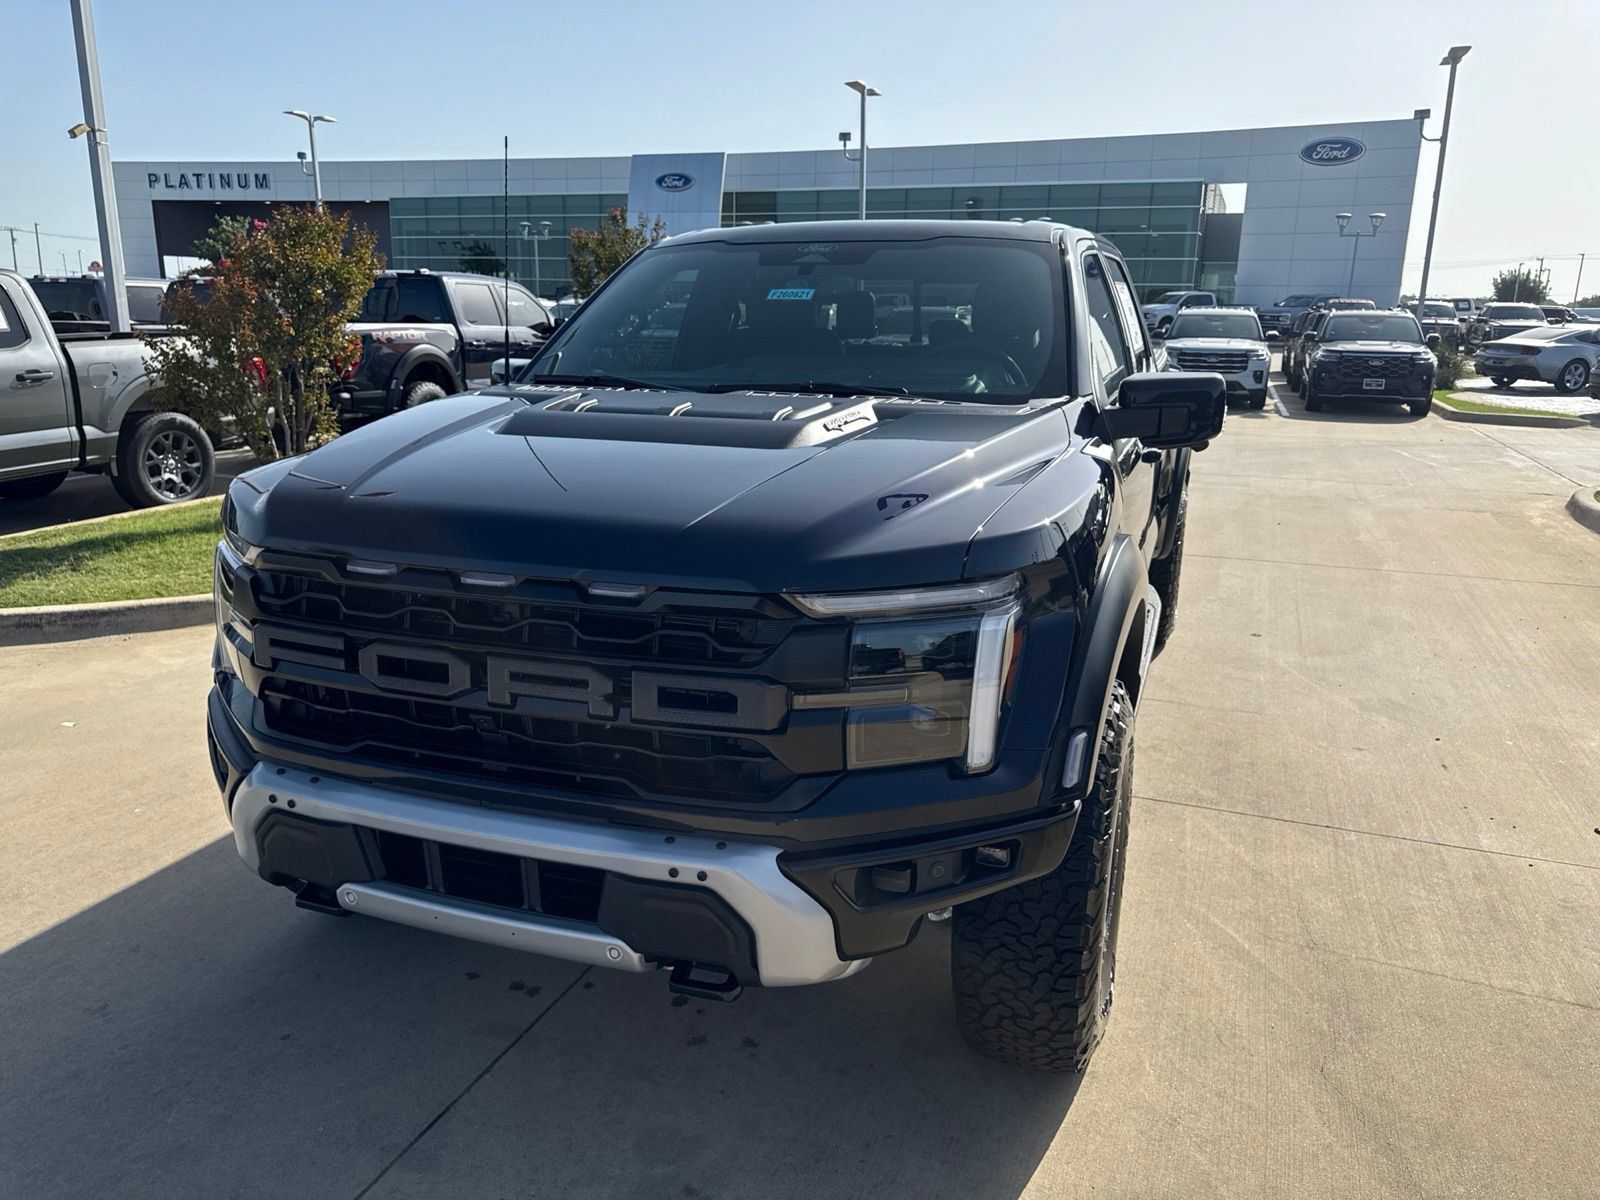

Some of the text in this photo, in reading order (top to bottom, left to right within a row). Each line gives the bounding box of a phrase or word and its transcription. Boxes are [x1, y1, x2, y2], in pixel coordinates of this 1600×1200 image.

[1312, 143, 1351, 159] Ford
[147, 173, 270, 190] PLATINUM
[662, 175, 685, 187] Ford
[371, 330, 429, 343] RAPTOR
[253, 623, 788, 731] FORD
